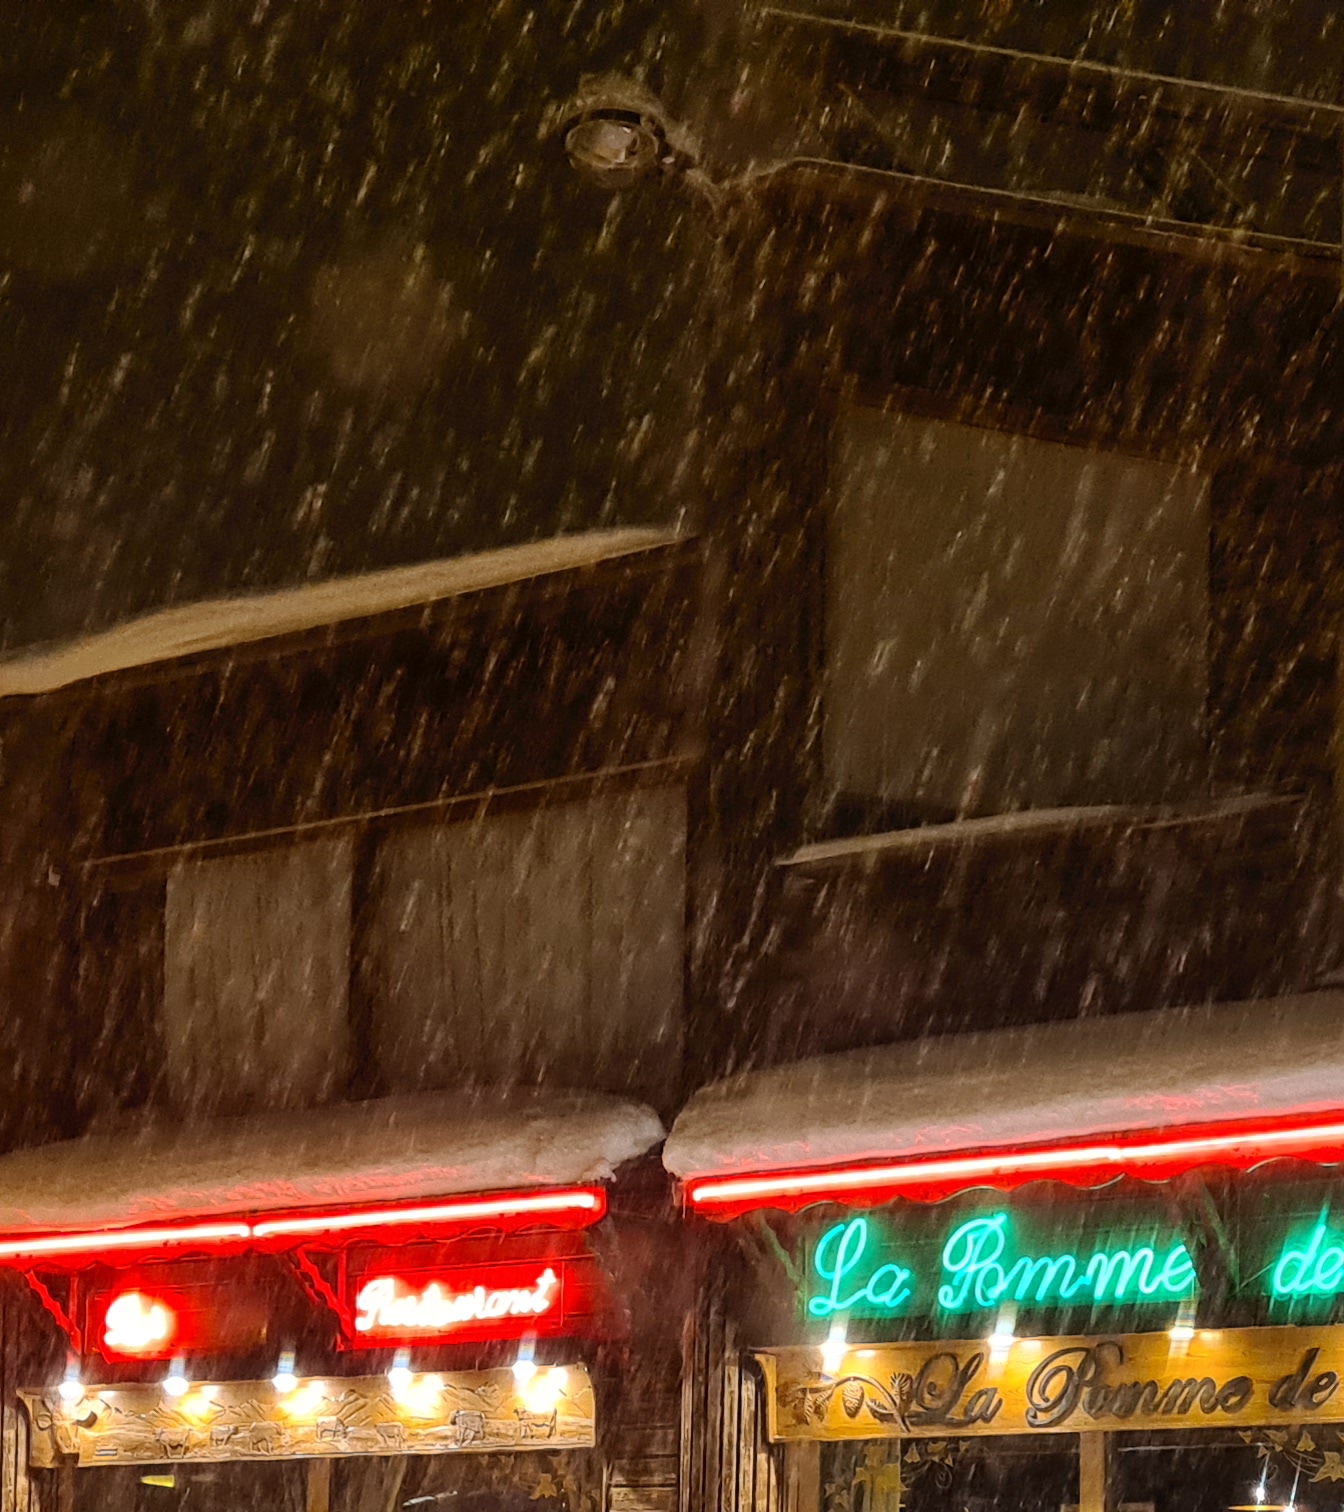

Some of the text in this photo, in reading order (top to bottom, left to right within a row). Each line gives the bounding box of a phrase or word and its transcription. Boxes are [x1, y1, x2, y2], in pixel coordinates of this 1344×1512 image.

[808, 1216, 912, 1317] La
[937, 1212, 1196, 1309] Pomme
[906, 1350, 1004, 1427] La
[1268, 1346, 1340, 1412] de
